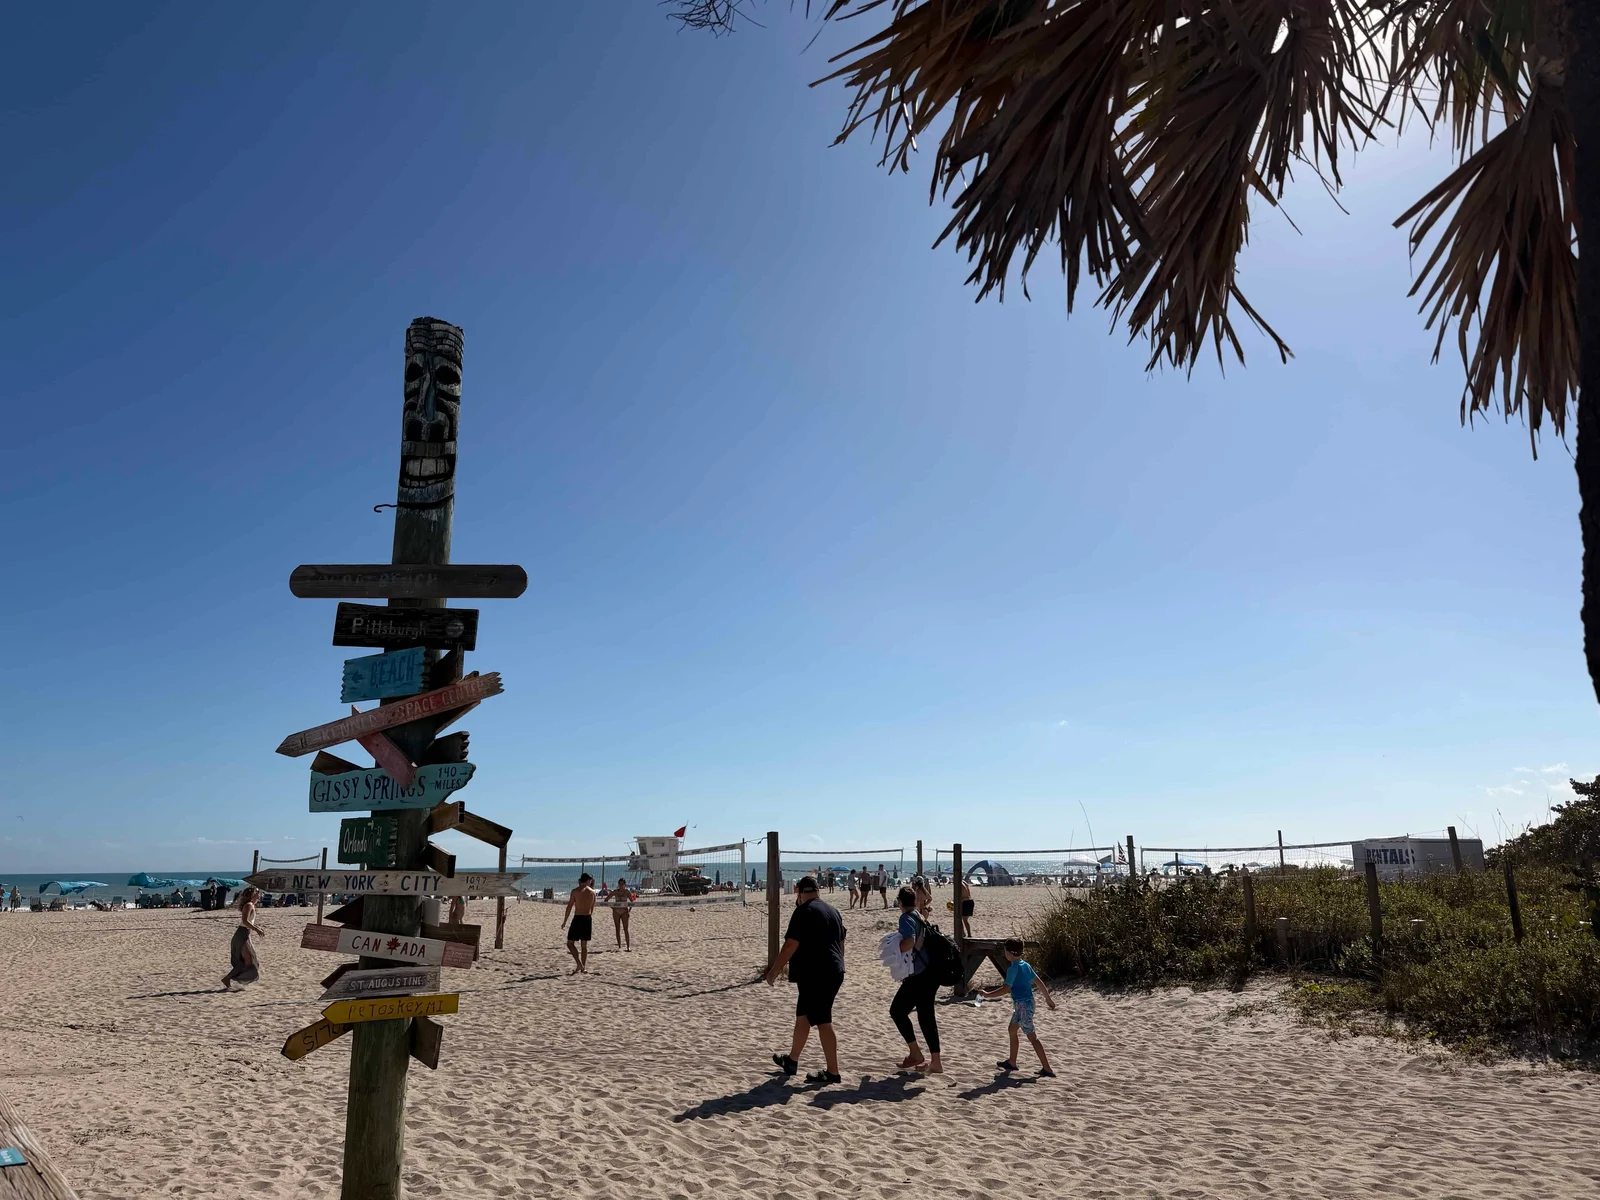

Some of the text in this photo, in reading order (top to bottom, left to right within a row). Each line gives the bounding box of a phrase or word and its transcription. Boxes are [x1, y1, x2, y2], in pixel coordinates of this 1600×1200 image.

[351, 616, 427, 640] Pittsburgh
[369, 653, 417, 687] BEACH
[397, 696, 437, 720] SPACE
[441, 680, 484, 705] CENTER
[438, 766, 458, 779] 140
[434, 779, 462, 790] MILES
[343, 826, 368, 855] Orlando
[1366, 848, 1416, 865] RENTALS
[292, 875, 331, 890] NEW
[343, 875, 377, 890] YORK
[400, 875, 443, 891] CITY
[466, 876, 488, 885] 1097
[367, 976, 423, 989] AUGUSTINE
